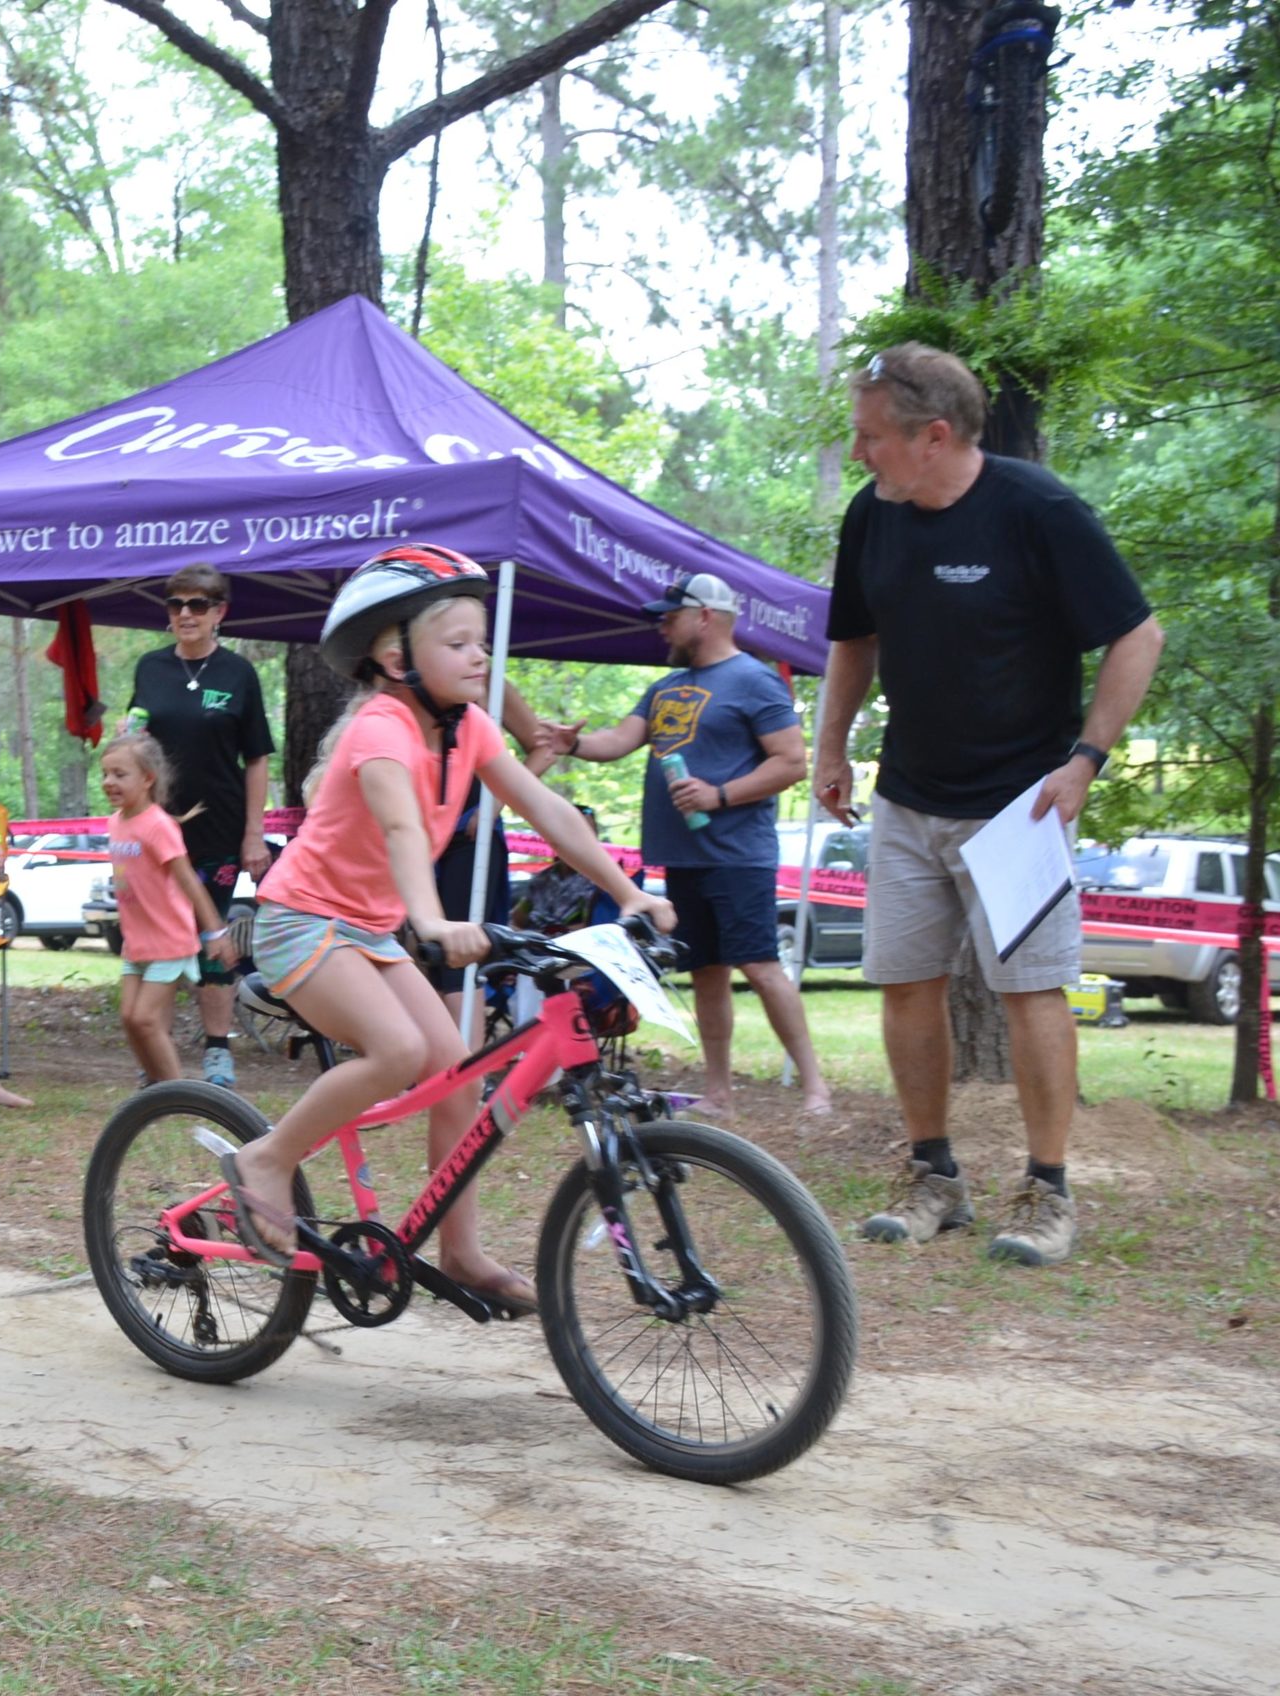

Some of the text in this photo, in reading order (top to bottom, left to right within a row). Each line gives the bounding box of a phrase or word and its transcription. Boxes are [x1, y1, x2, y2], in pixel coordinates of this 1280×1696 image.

[44, 406, 410, 472] Curves
[67, 521, 105, 550] to
[114, 518, 231, 548] amaze
[568, 511, 609, 563] The
[613, 542, 672, 587] power
[1115, 897, 1198, 915] CAUTION
